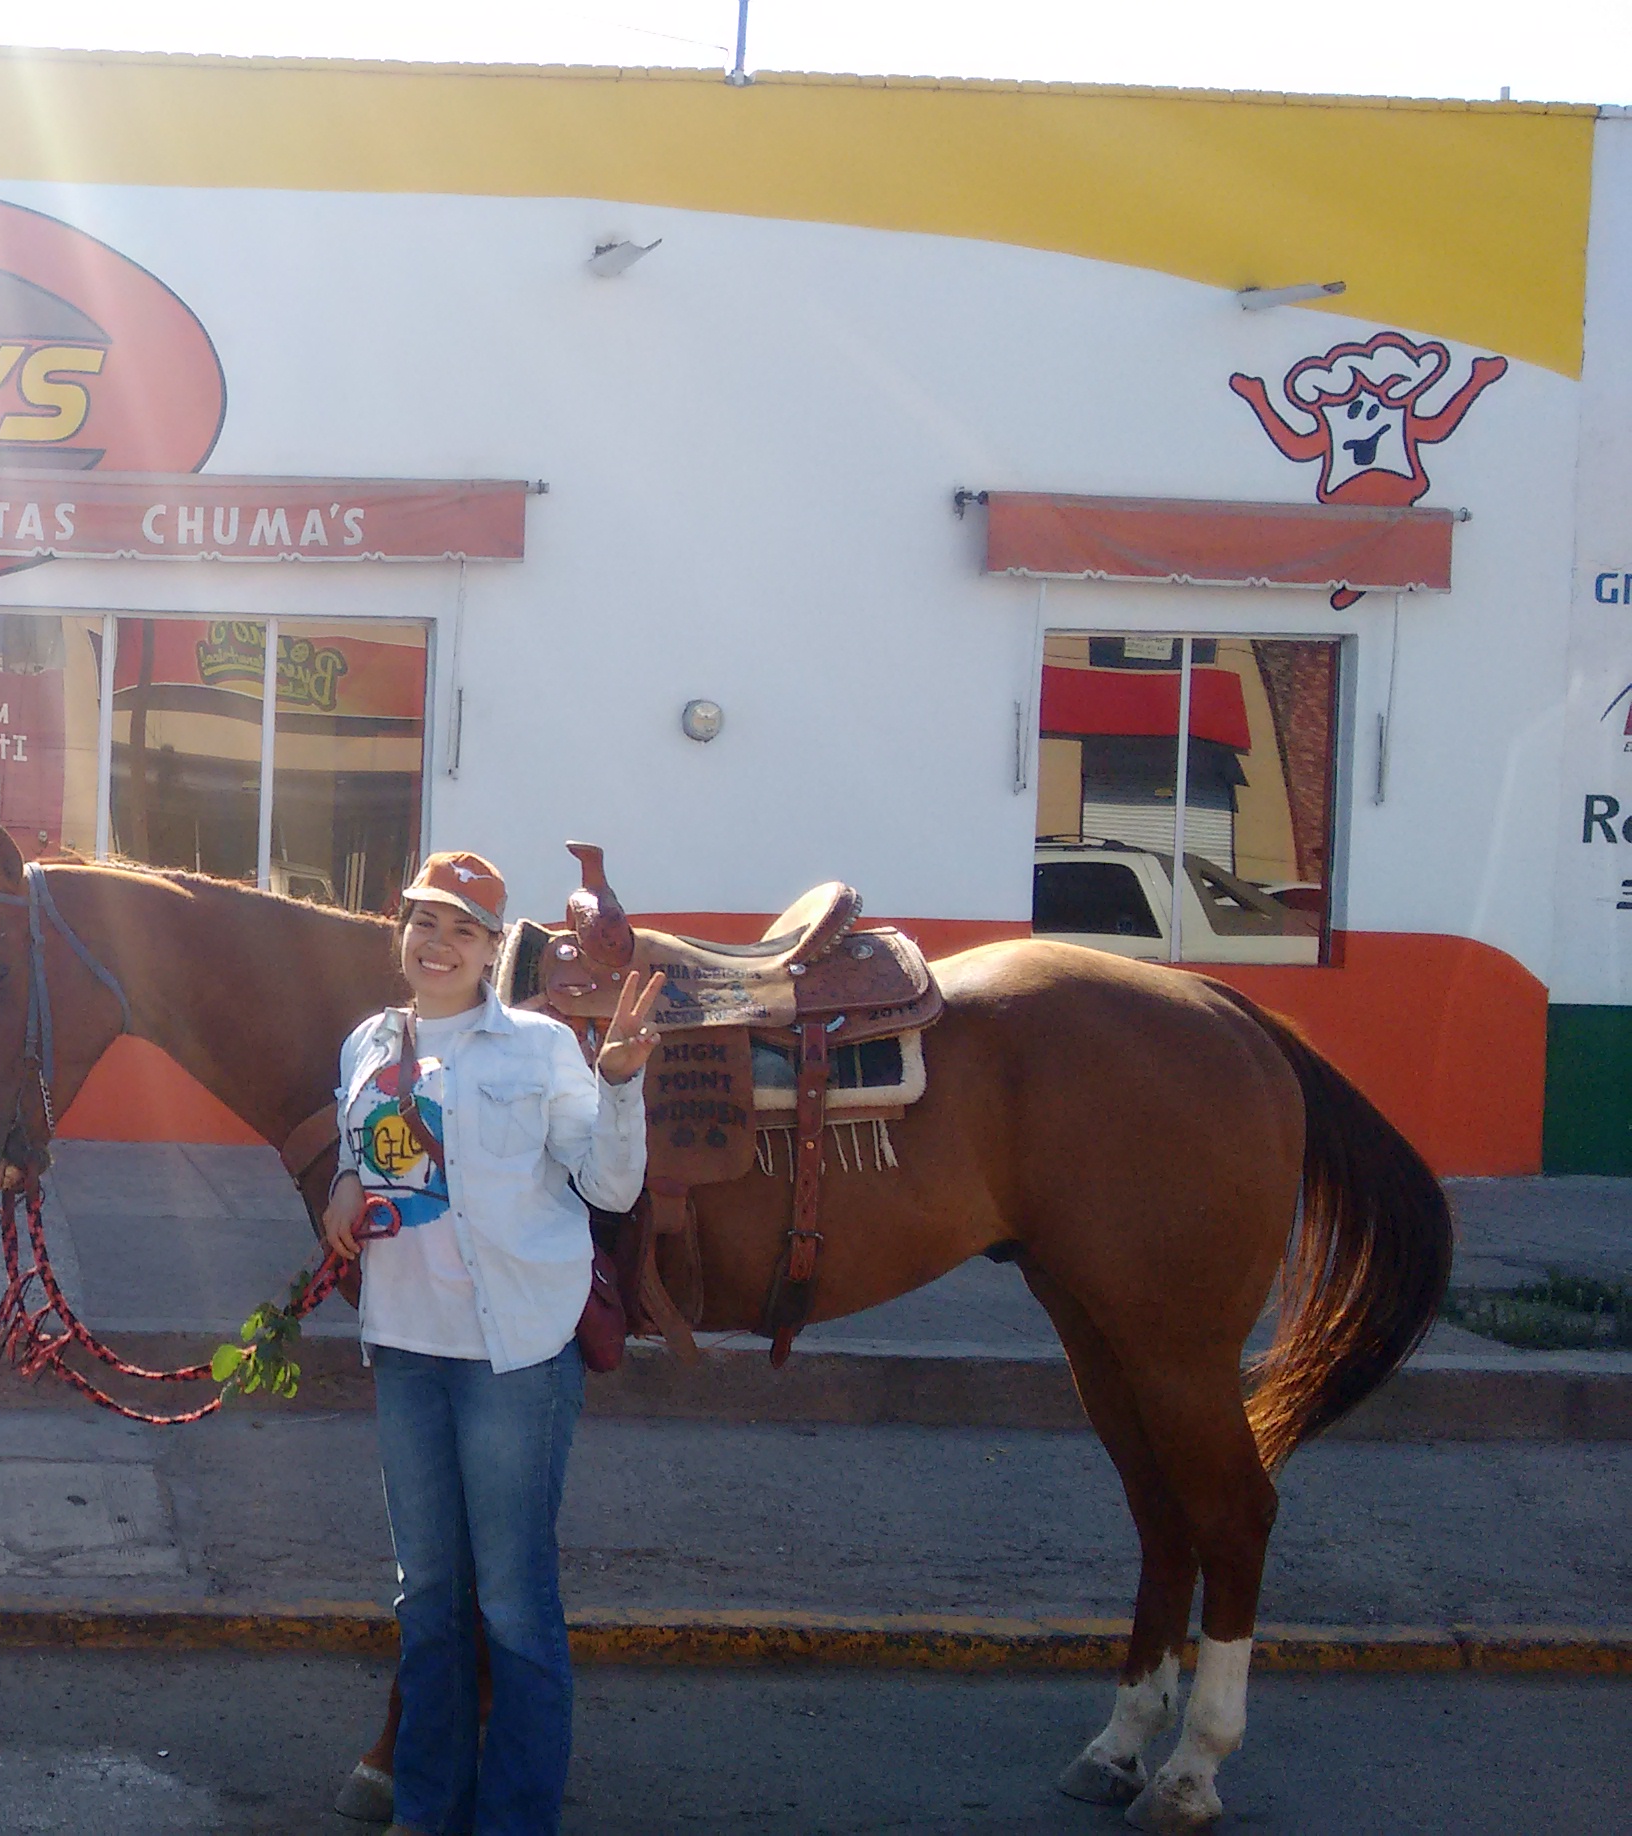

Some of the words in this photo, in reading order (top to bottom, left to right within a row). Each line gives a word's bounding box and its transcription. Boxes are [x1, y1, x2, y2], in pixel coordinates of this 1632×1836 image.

[141, 503, 366, 547] CHUMA'S
[663, 1043, 727, 1063] HIGH
[657, 1070, 732, 1094] POINT
